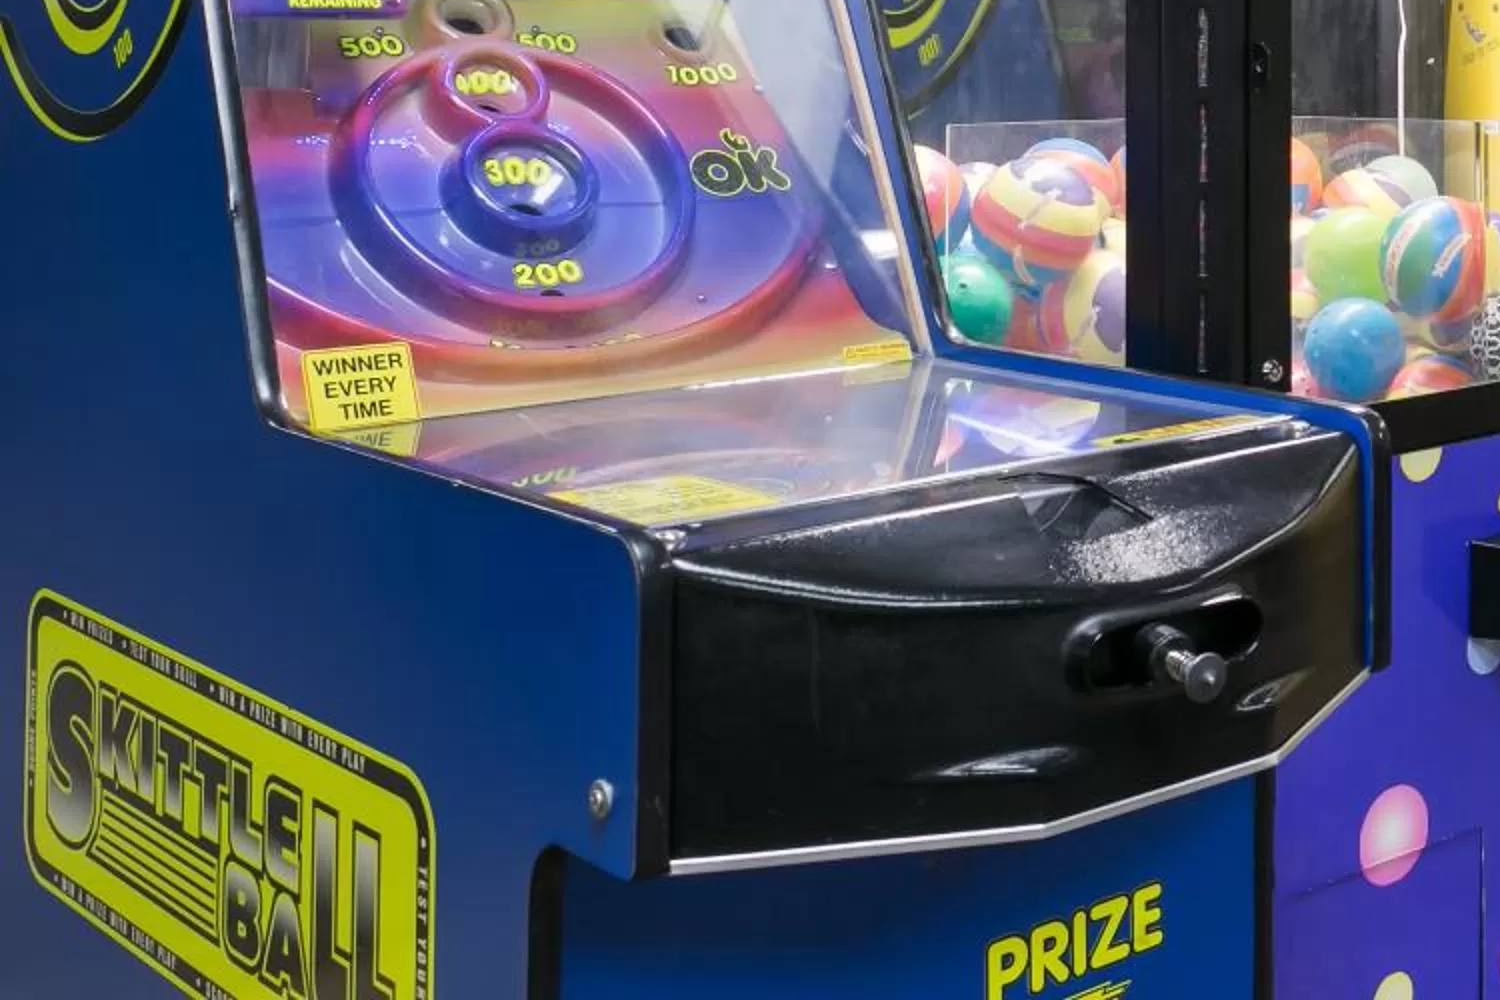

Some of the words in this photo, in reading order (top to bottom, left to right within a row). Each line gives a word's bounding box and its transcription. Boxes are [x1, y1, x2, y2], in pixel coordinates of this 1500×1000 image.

[339, 35, 405, 58] 500
[516, 33, 578, 55] 500
[666, 63, 738, 87] 1000
[483, 157, 554, 187] 300
[690, 136, 792, 198] OK
[512, 258, 585, 289] 200
[312, 352, 404, 377] WINNER
[323, 375, 398, 400] EVERY
[338, 399, 394, 422] TIME
[45, 657, 305, 896] SKITTLE
[221, 797, 400, 1000] BALL
[416, 867, 429, 925] TEST
[983, 880, 1168, 1000] PRIZE
